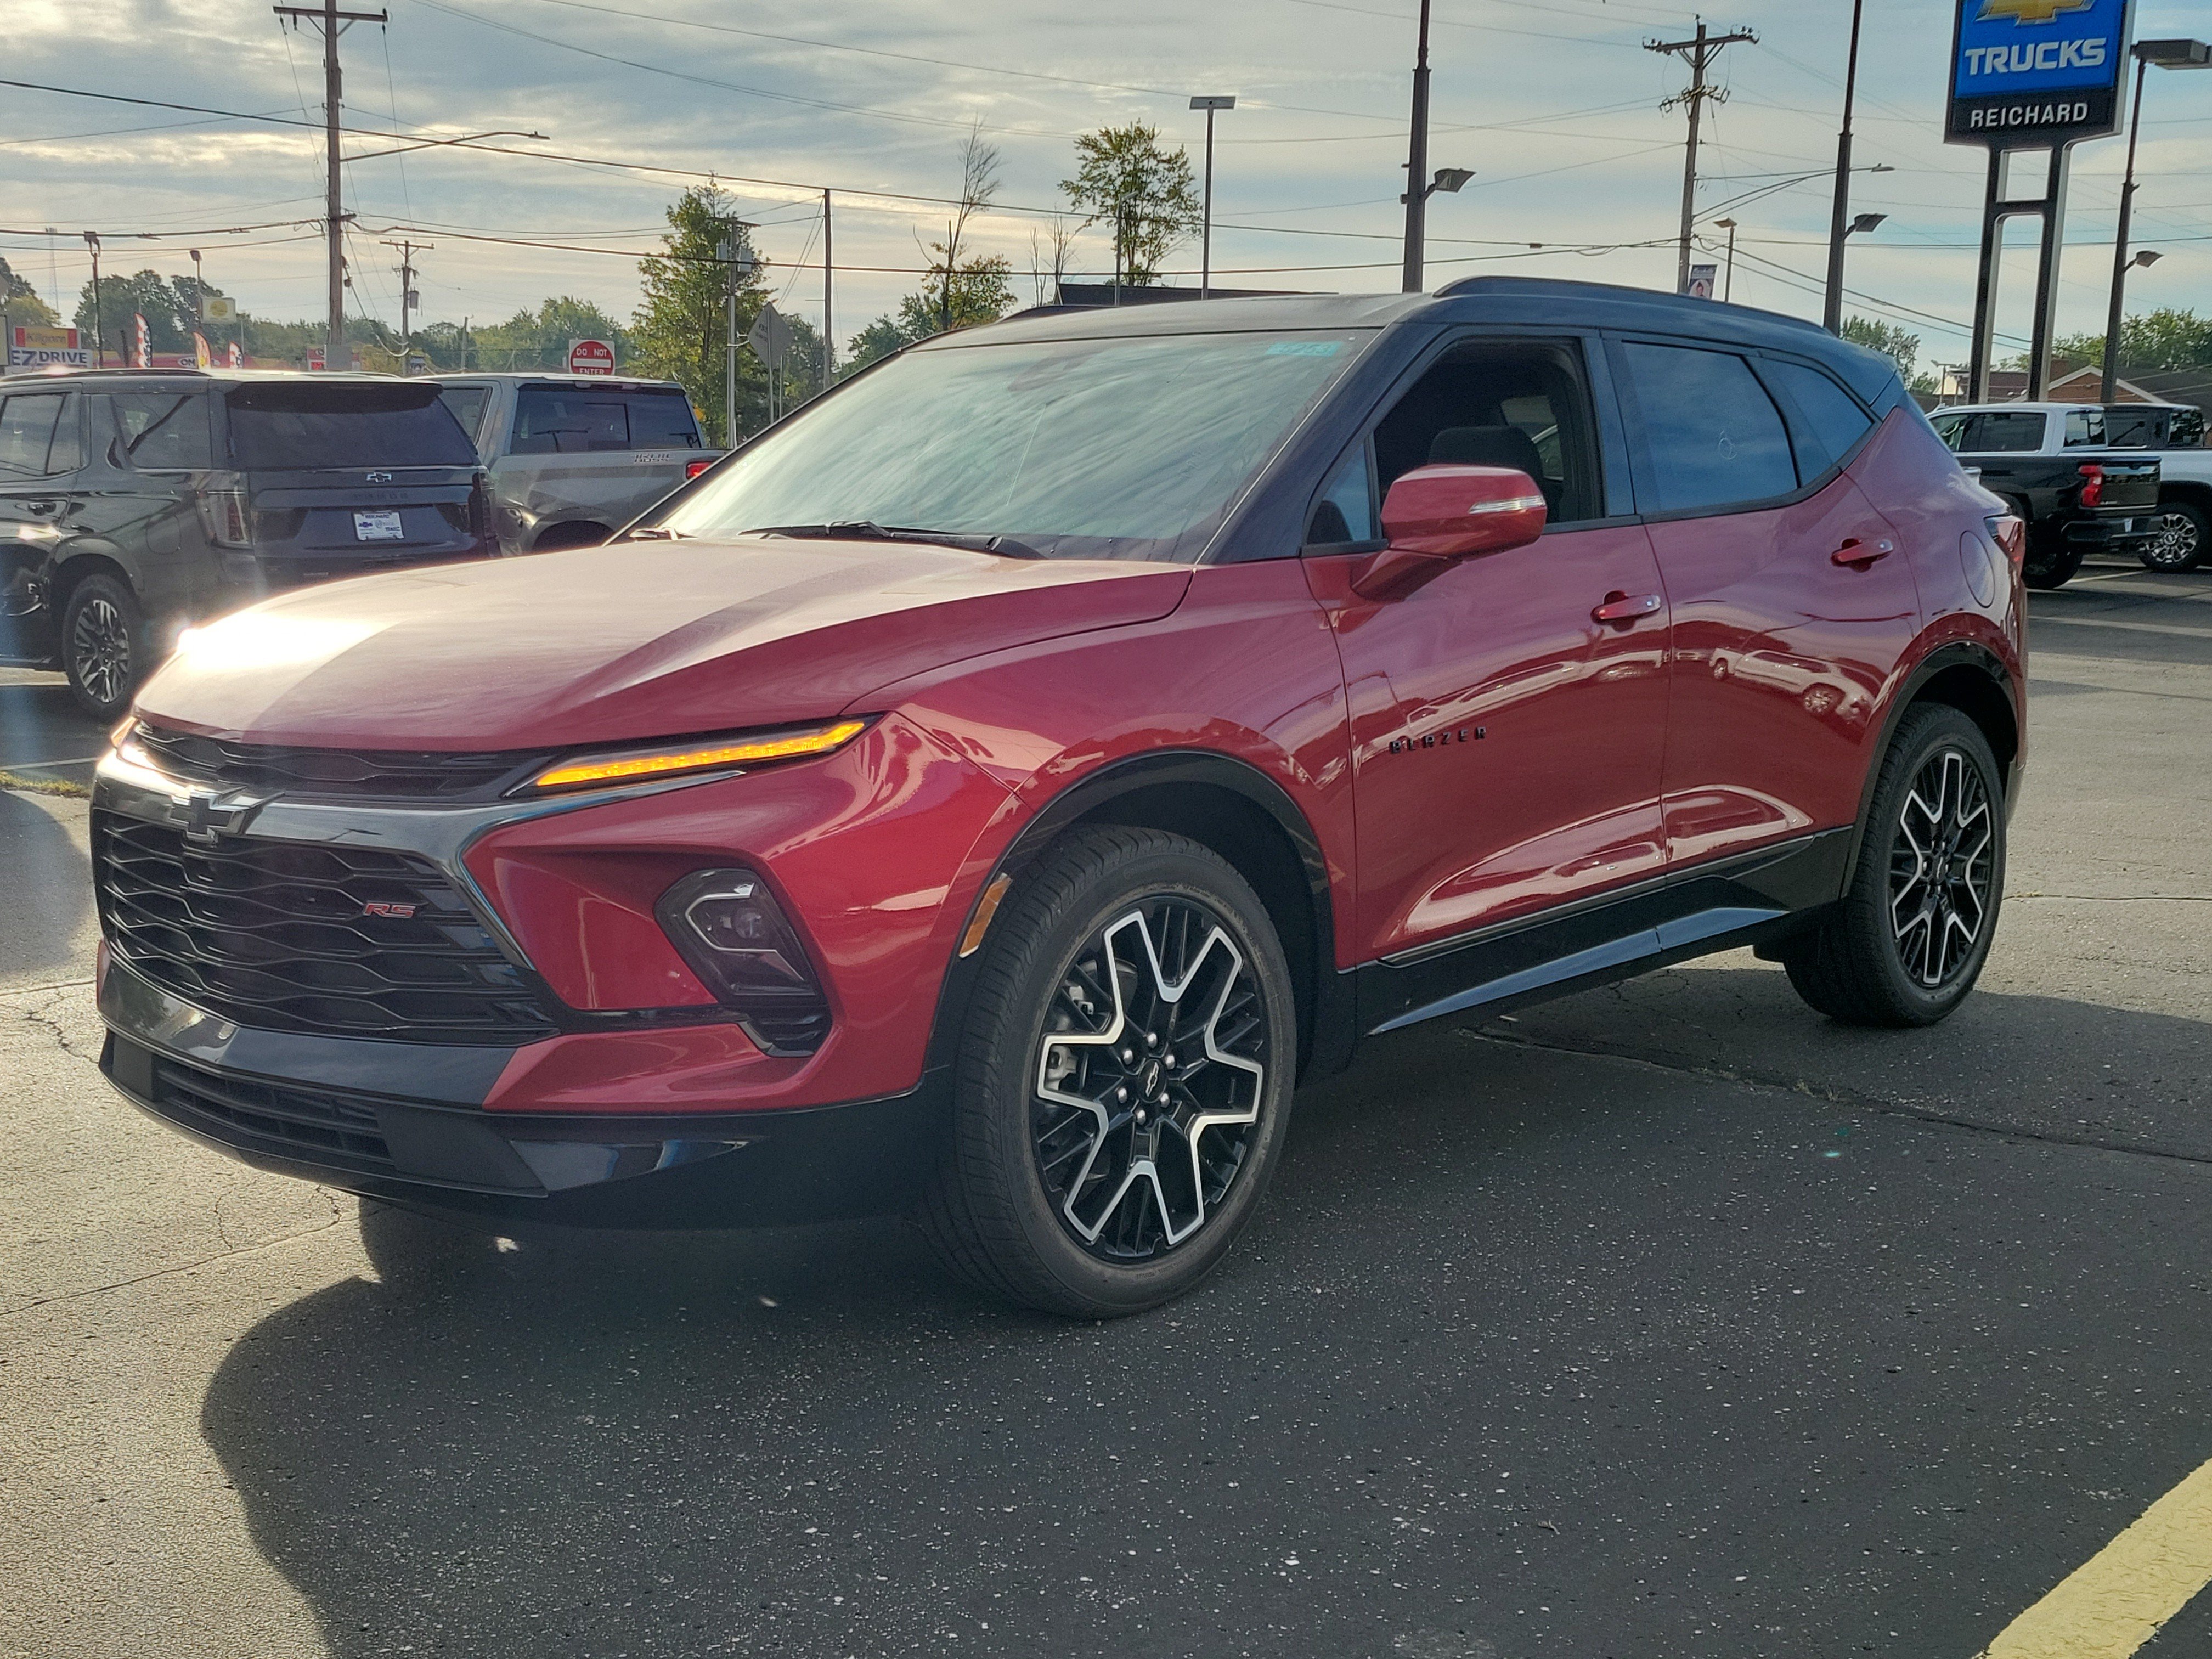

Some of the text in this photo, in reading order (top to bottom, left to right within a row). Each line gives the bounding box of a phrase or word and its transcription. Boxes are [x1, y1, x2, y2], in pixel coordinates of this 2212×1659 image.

[1965, 37, 2106, 75] TRUCKS
[1970, 102, 2088, 128] REICHARD
[39, 351, 87, 363] DRIVE
[576, 348, 608, 357] DO NOT
[1390, 727, 1486, 753] BLAZER
[363, 903, 416, 918] RS
